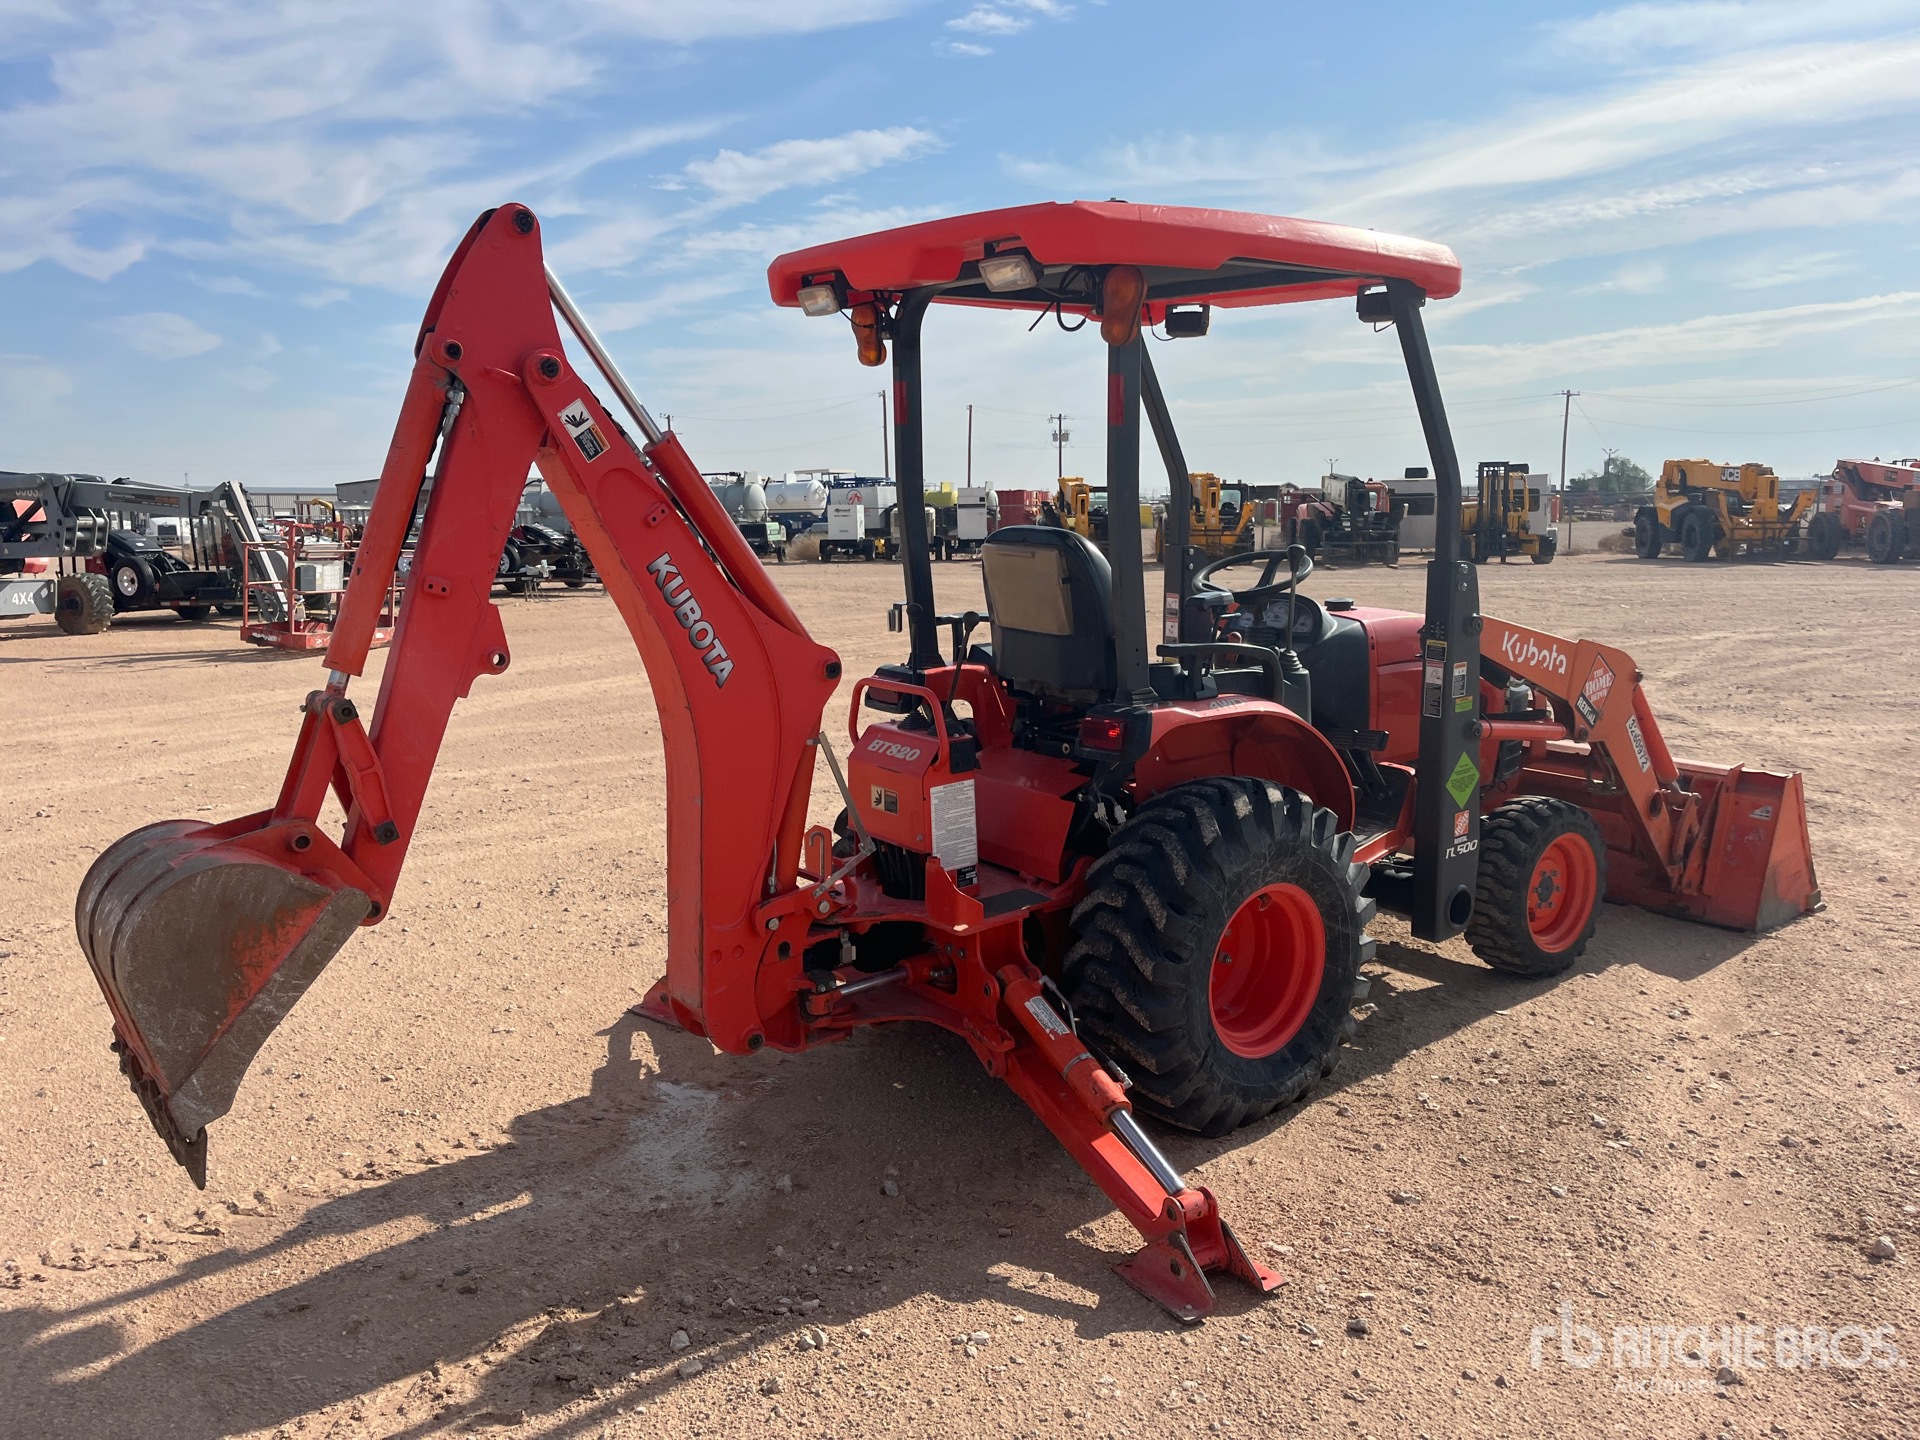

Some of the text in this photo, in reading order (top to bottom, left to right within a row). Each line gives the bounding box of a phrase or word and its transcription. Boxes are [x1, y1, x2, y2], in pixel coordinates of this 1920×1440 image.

[1721, 468, 1741, 481] JCB
[12, 592, 34, 605] 4X4
[646, 552, 735, 689] KUBOTA
[1501, 631, 1567, 675] Kubota
[1585, 673, 1613, 695] HOME
[1576, 696, 1596, 726] RENTAL
[866, 738, 921, 761] BT820
